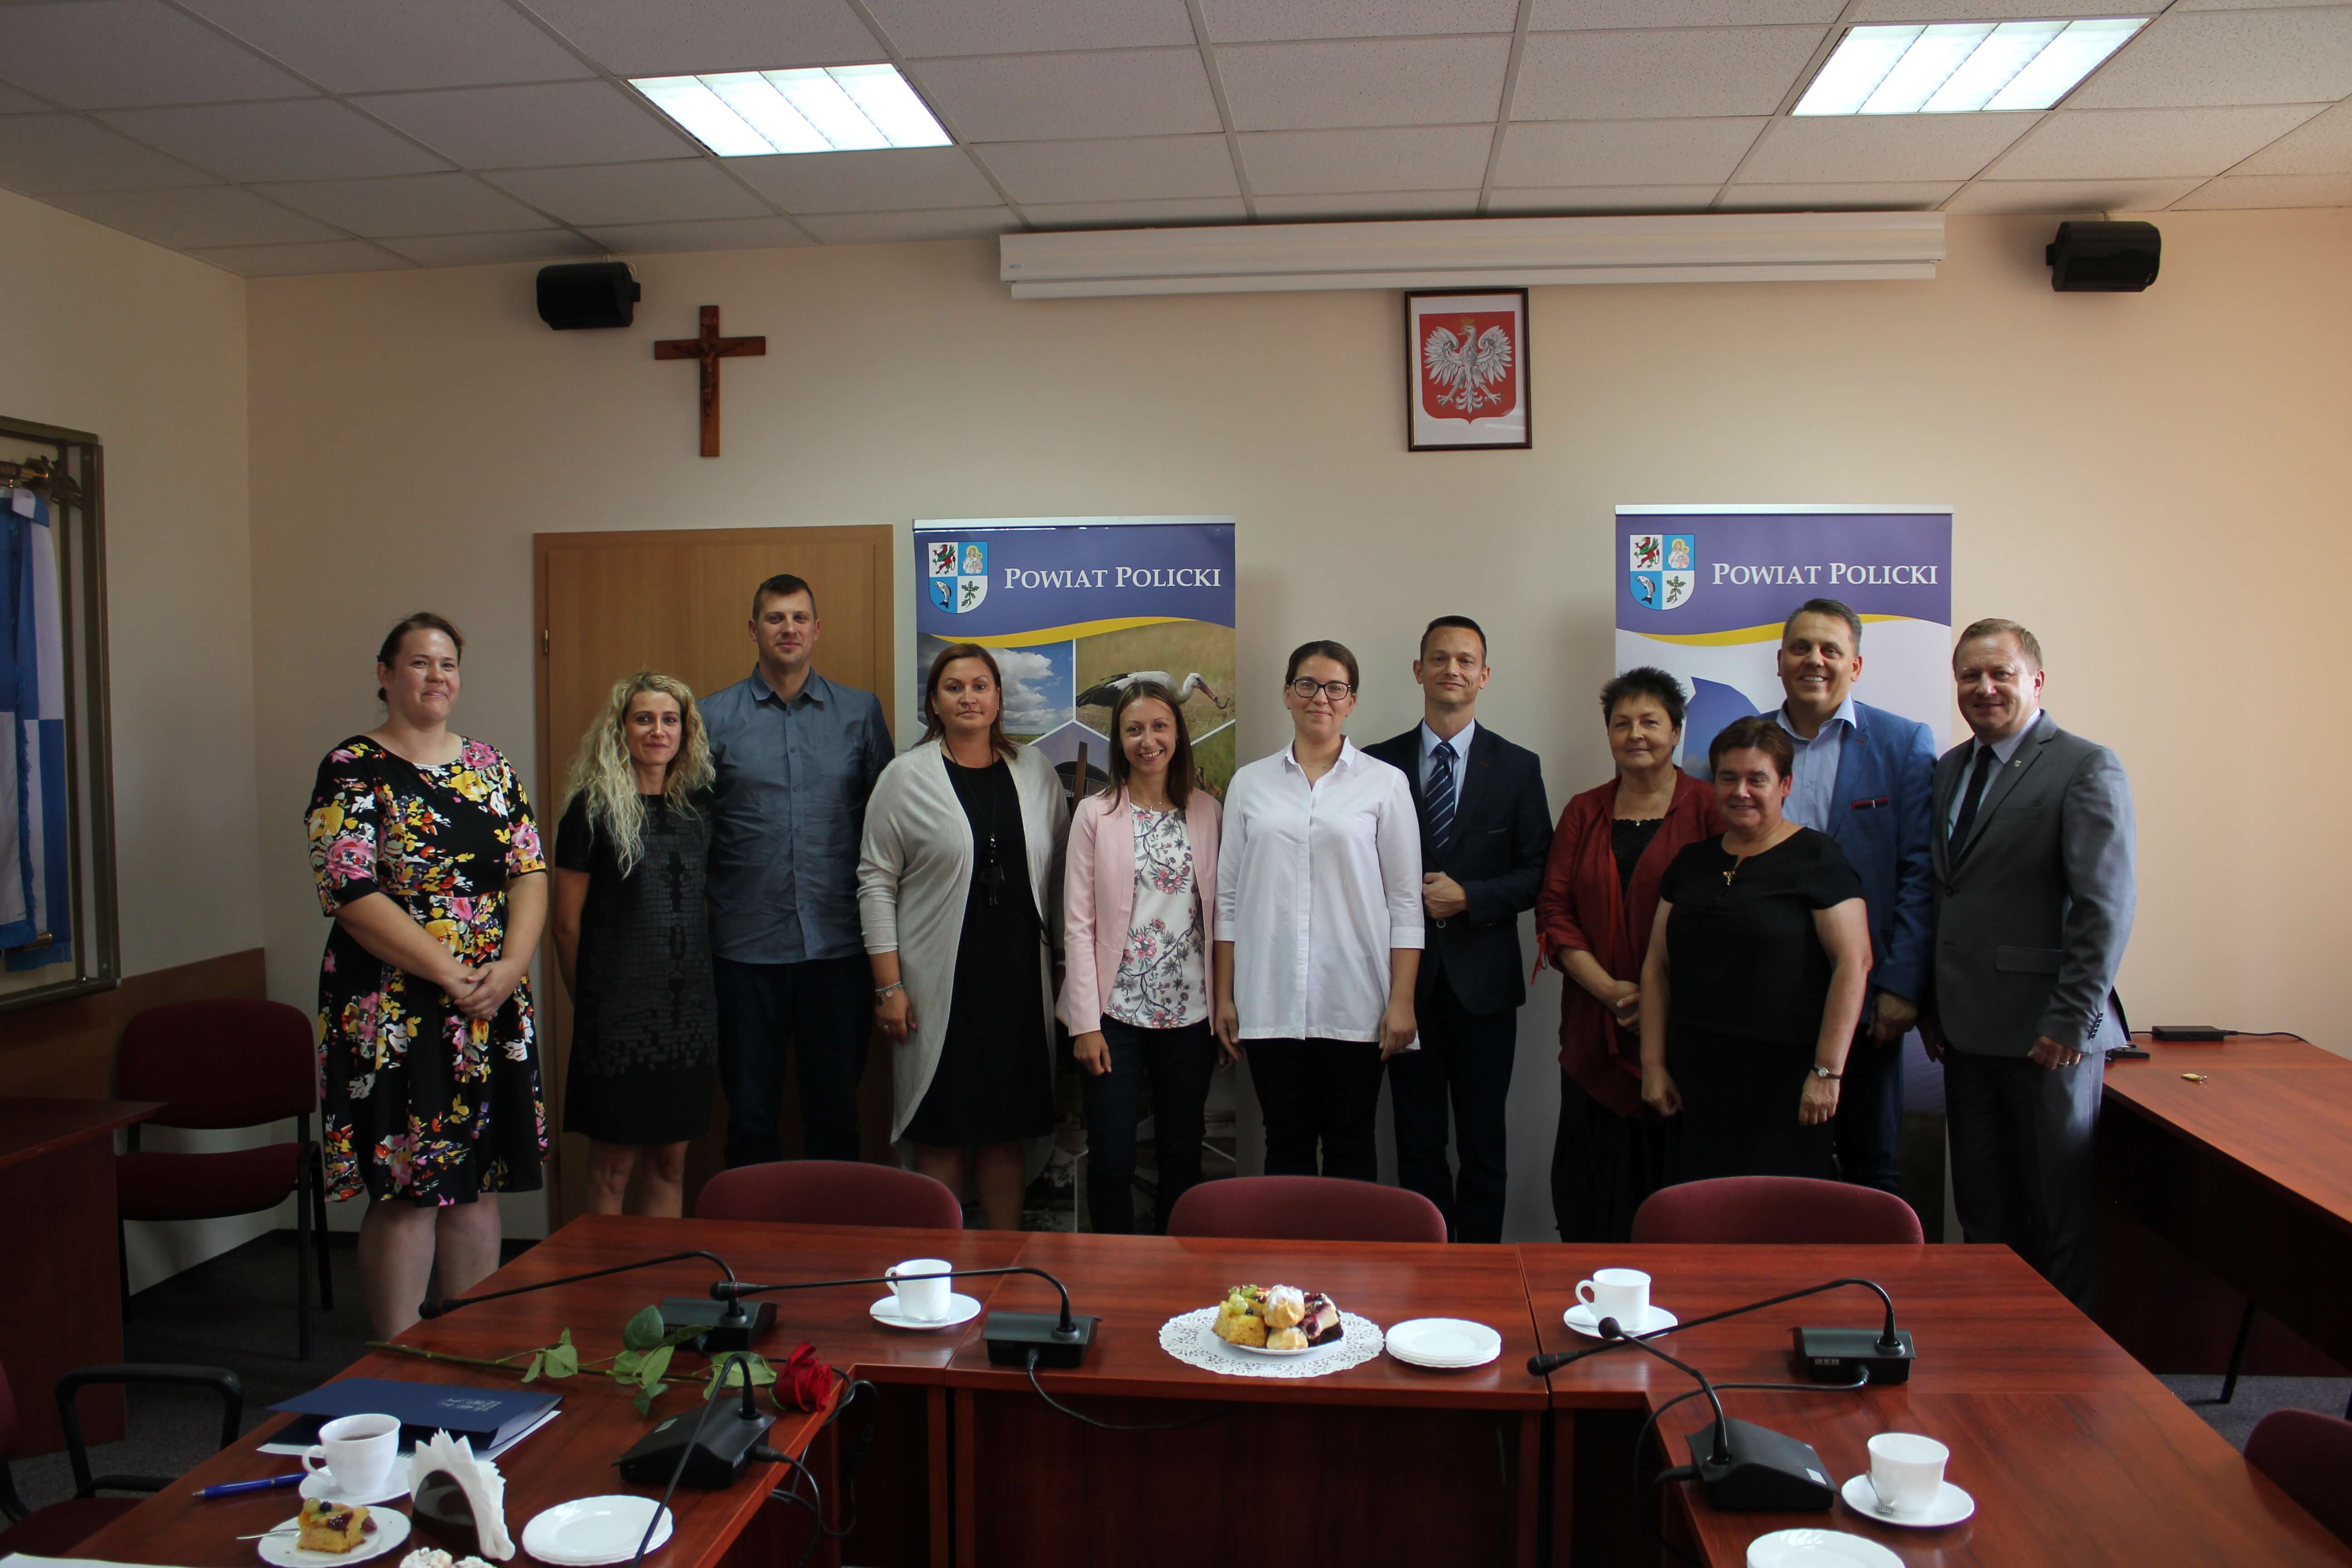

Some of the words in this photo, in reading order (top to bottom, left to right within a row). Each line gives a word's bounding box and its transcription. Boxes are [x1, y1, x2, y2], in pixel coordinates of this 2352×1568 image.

[1004, 568, 1108, 589] POWIAT
[1115, 566, 1221, 588] POLICKI
[1711, 563, 1822, 585] POWIAT
[1828, 562, 1938, 585] POLICKI
